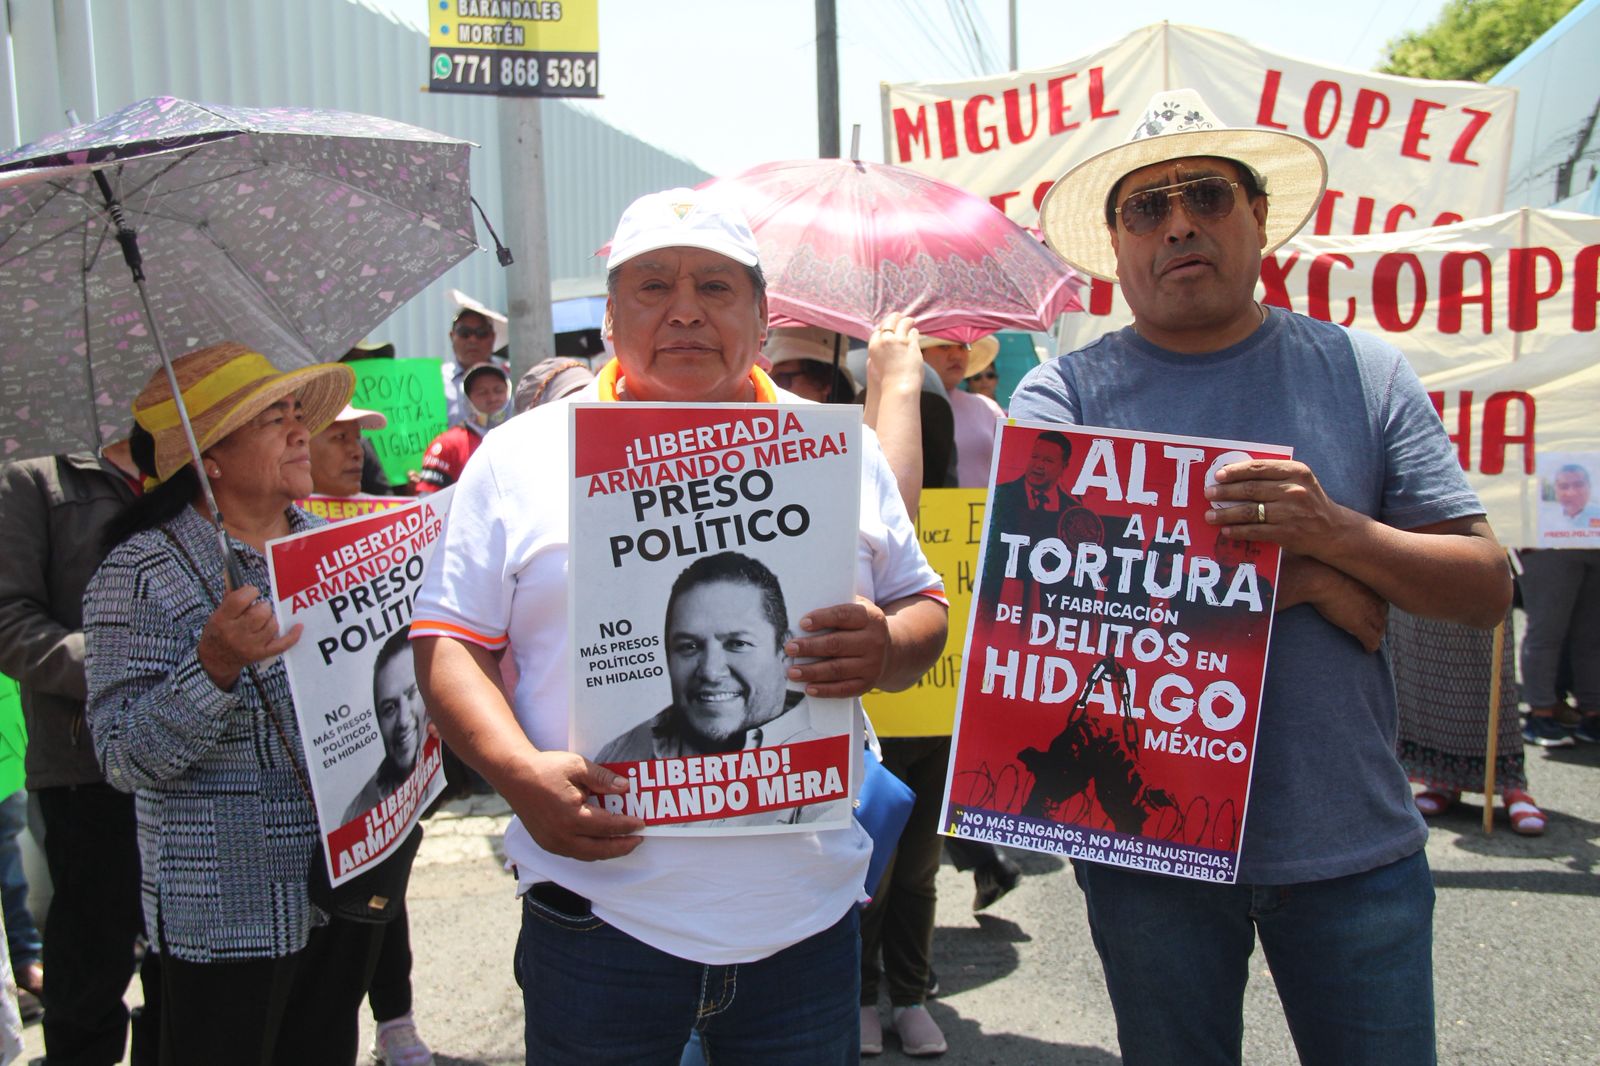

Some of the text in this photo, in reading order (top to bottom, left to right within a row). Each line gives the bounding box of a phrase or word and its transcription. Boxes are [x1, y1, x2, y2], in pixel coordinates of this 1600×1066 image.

[458, 0, 562, 20] BARANDALES
[458, 22, 525, 46] MORTÉN
[453, 55, 597, 88] 771 868 5361
[893, 66, 1492, 166] MIGUEL LOPEZ
[625, 412, 804, 468] ¡LIBERTAD A
[587, 431, 848, 497] ARMANDO MERA!
[631, 469, 774, 522] PRESO
[315, 503, 435, 581] ¡LIBERTAD A
[609, 503, 810, 568] POLÍTICO
[1122, 513, 1192, 547] A LA
[291, 547, 407, 615] ARMANDO
[328, 555, 424, 624] PRESO
[1000, 532, 1263, 612] TORTURA
[599, 619, 632, 639] NO
[1045, 593, 1179, 626] Y FABRICACIÓN
[580, 635, 659, 658] MÁS PRESOS
[995, 603, 1228, 673] DE DELITOS EN
[586, 666, 663, 688] EN HIDALGO
[589, 652, 655, 672] POLÍTICOS
[980, 646, 1247, 732] HIDALGO
[313, 708, 373, 747] MÁS PRESOS
[324, 704, 351, 726] NO
[323, 722, 372, 755] POLÍTICOS
[323, 731, 379, 769] EN HIDALGO
[1143, 726, 1247, 764] MÉXICO
[628, 747, 791, 794] ¡LIBERTAD!
[757, 766, 844, 806] MERA
[339, 790, 417, 876] ARMANDO
[949, 822, 971, 836] NO
[974, 827, 1002, 843] MÁS
[1071, 844, 1105, 861] PARA
[1108, 851, 1171, 872] NUESTRO
[986, 816, 1015, 831] MÁS
[1018, 822, 1086, 846] ENGAÑOS,
[1089, 834, 1111, 848] NO
[1114, 837, 1143, 853] MÁS
[1146, 844, 1233, 871] INJUSTICIAS,
